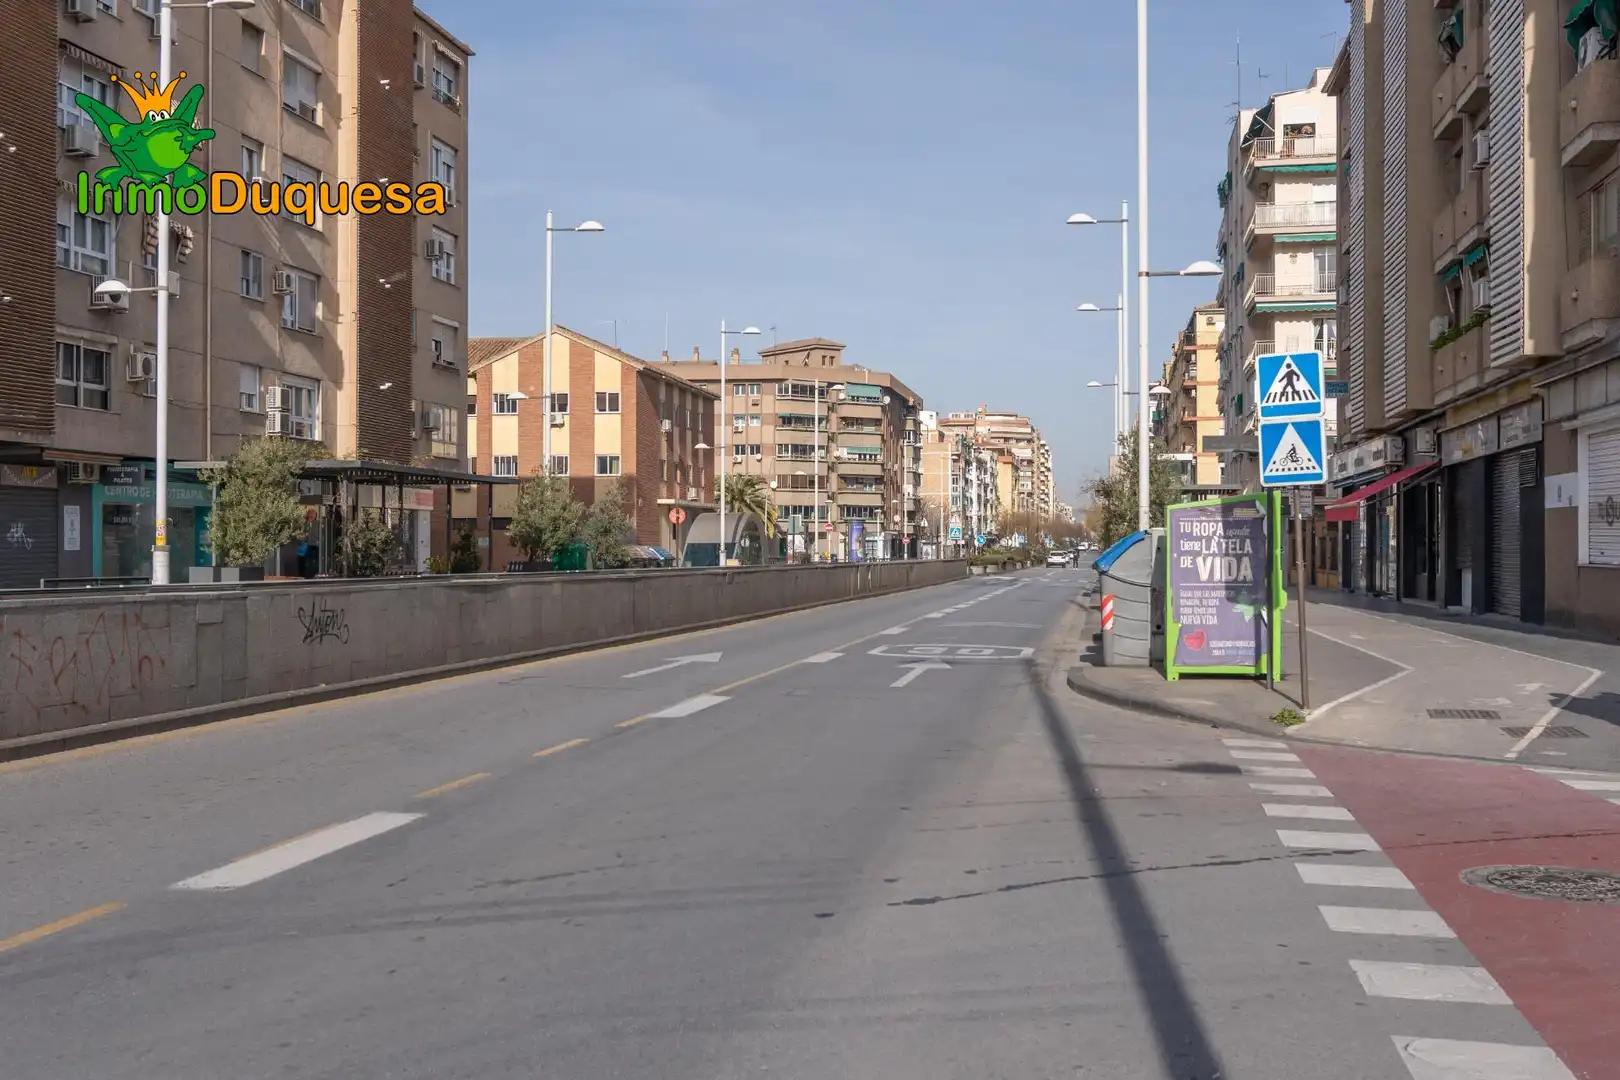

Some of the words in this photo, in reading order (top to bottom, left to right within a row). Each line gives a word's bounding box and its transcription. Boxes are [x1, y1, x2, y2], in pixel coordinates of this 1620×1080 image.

[104, 485, 138, 498] CENTRO
[139, 487, 151, 498] DE
[152, 488, 204, 501] FOTERAPIA
[1179, 522, 1191, 533] TU
[1193, 522, 1224, 537] ROPA
[1180, 538, 1201, 551] tiene
[1220, 539, 1252, 554] TELA
[1180, 556, 1194, 568] DE
[1195, 556, 1253, 582] VIDA
[1180, 615, 1201, 625] NUEVA
[1202, 615, 1217, 625] VIDA
